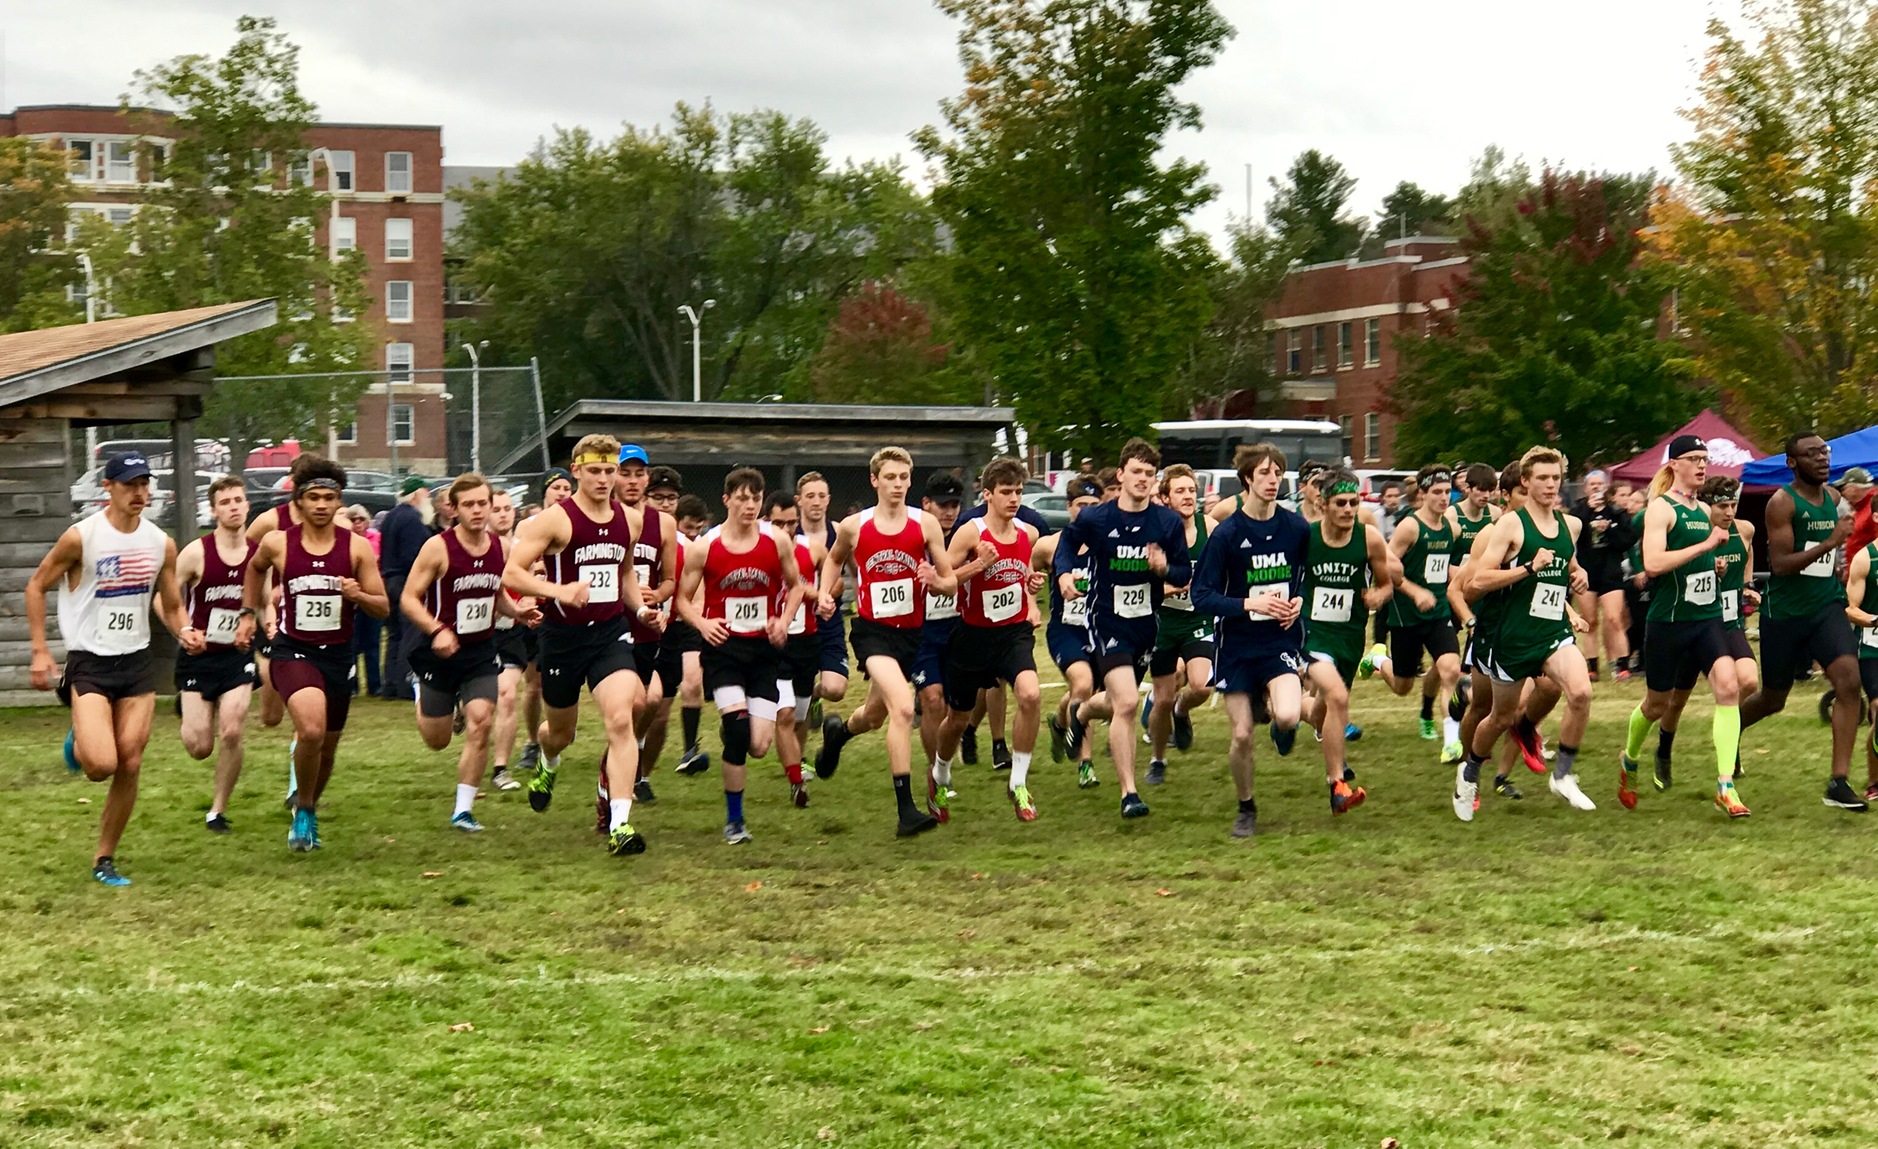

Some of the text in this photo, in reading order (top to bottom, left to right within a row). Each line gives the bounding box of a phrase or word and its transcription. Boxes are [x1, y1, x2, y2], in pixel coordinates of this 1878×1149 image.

[1251, 552, 1287, 570] UMA
[1312, 562, 1358, 577] UNITY
[589, 571, 611, 588] 232
[1319, 574, 1350, 583] COLLEGE
[1693, 577, 1712, 593] 215
[881, 586, 905, 603] 206
[992, 591, 1015, 609] 202
[1123, 590, 1145, 606] 229
[1321, 593, 1344, 610] 244
[1541, 590, 1561, 607] 241
[306, 602, 332, 618] 236
[466, 603, 488, 620] 230
[734, 603, 759, 619] 205
[1070, 601, 1086, 615] 22
[108, 612, 134, 630] 296
